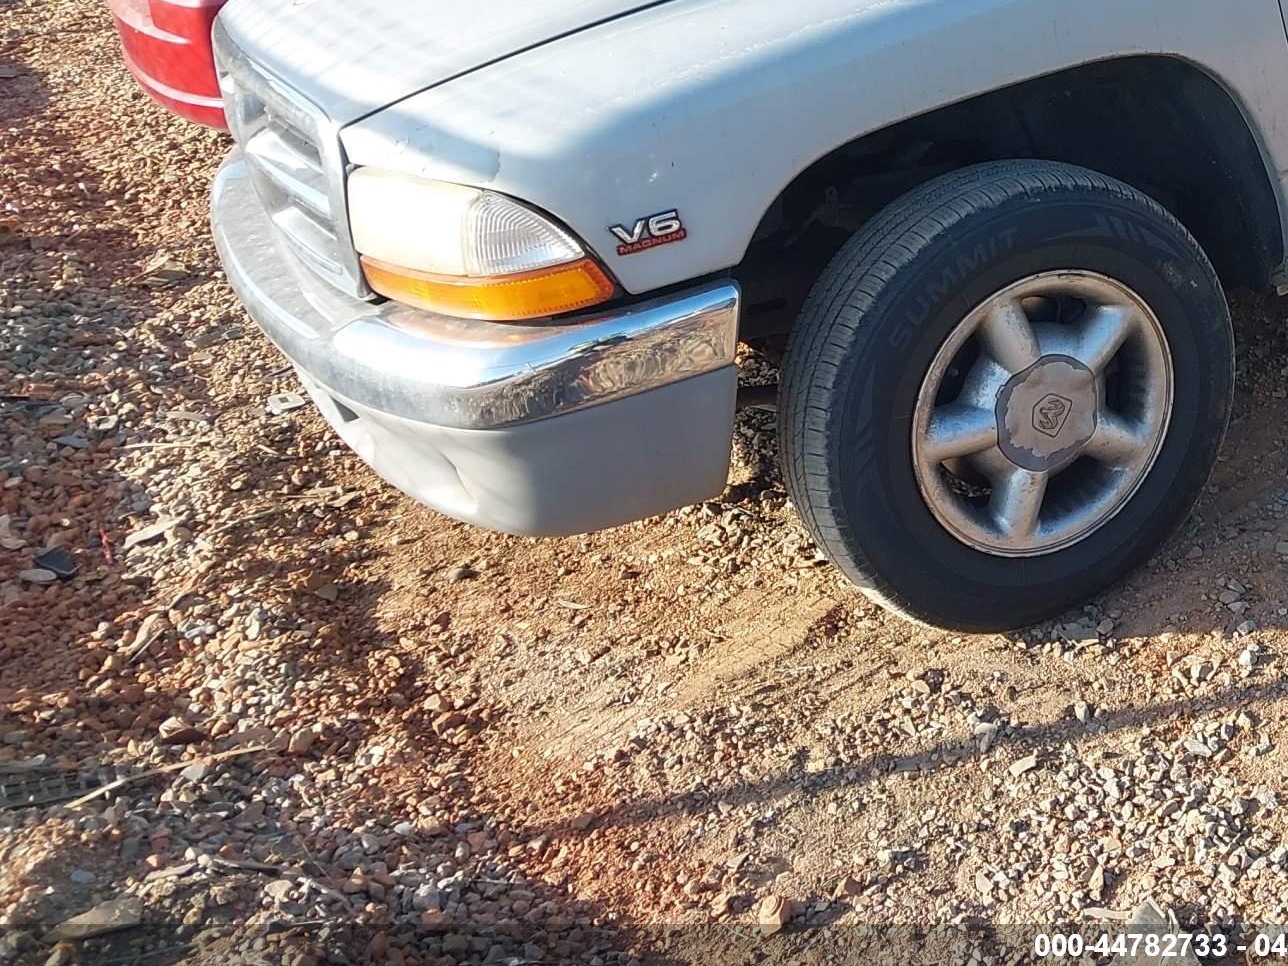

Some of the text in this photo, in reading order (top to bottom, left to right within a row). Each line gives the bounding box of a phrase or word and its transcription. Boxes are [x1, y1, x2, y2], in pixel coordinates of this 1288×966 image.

[608, 208, 682, 245] V6
[617, 229, 687, 255] MAGNUM
[887, 224, 1023, 351] SUMMIT
